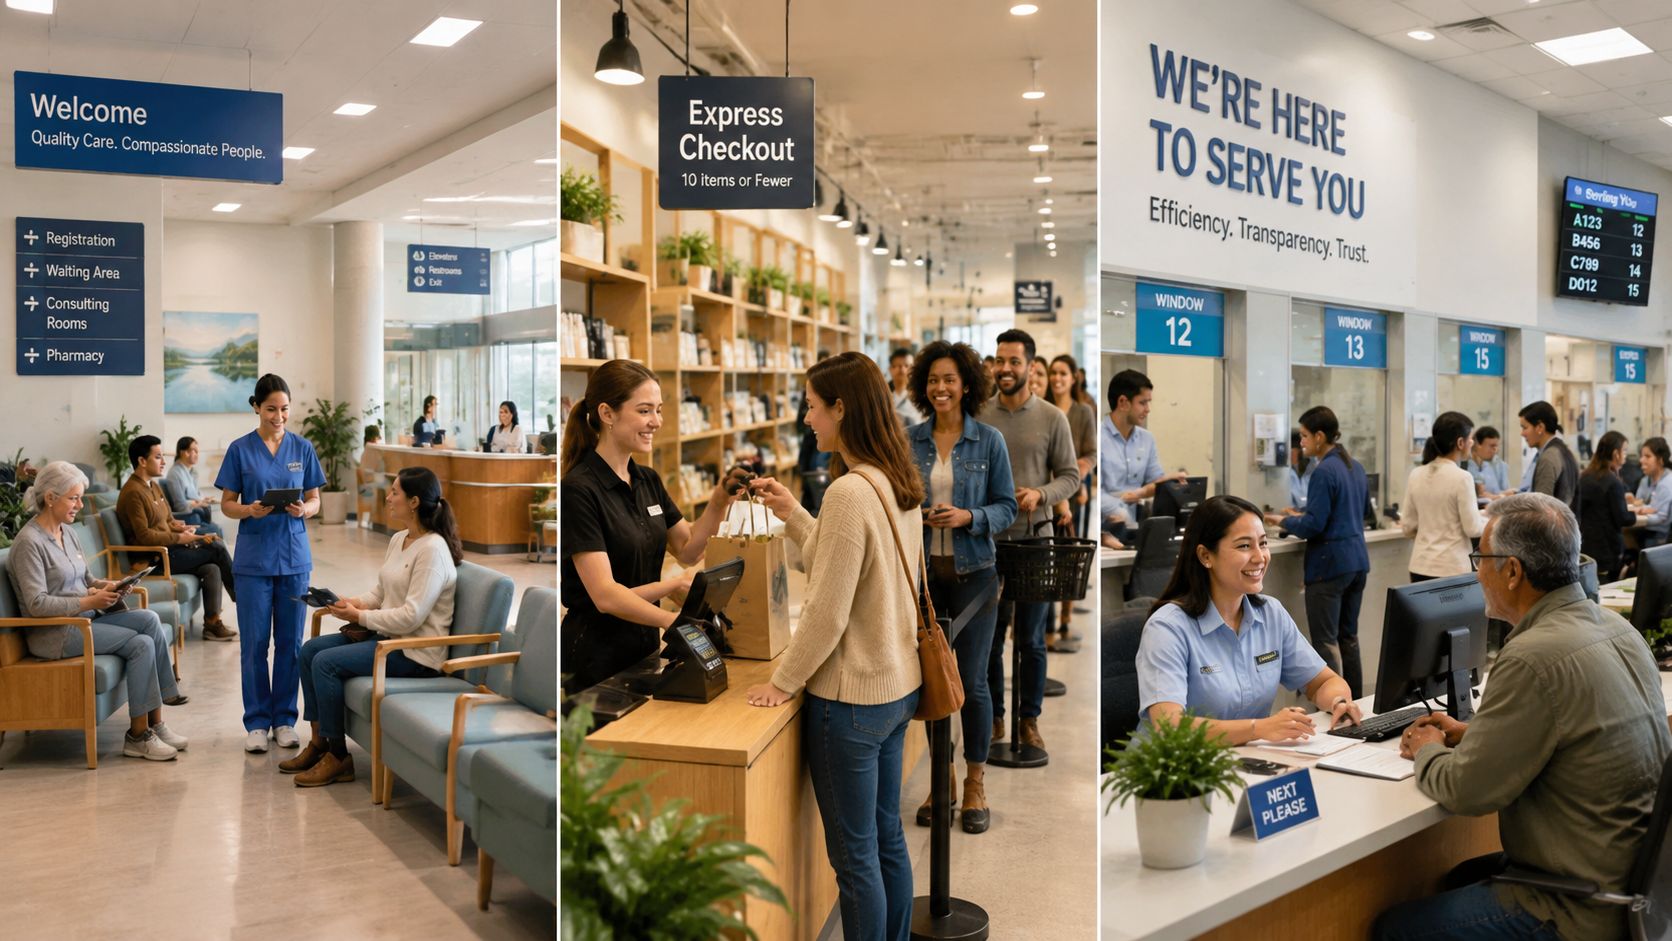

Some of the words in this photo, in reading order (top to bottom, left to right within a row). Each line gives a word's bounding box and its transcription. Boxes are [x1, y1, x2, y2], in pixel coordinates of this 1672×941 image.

[30, 92, 148, 125] Welcome
[689, 99, 784, 132] Express
[1272, 87, 1347, 157] HERE
[31, 129, 80, 150] Quality
[83, 133, 118, 150] Care.
[121, 136, 219, 156] Compassionate
[221, 142, 267, 162] People.
[679, 133, 796, 161] Checkout
[681, 173, 697, 187] 10
[701, 173, 736, 187] items
[739, 176, 752, 187] or
[755, 173, 793, 187] Fewer
[1150, 118, 1197, 178] TO
[1206, 137, 1304, 206] SERVE
[1311, 166, 1366, 220] YOU
[1150, 196, 1234, 242] Efficiency.
[1238, 216, 1333, 261] Transparency.
[1335, 238, 1370, 264] Trust.
[1573, 213, 1602, 230] A123
[1632, 223, 1644, 237] 12
[46, 231, 116, 248] Registration
[1572, 233, 1601, 250] B456
[1631, 243, 1643, 257] 13
[46, 264, 90, 281] Waiting
[93, 265, 120, 279] Area
[1629, 263, 1641, 278] 14
[1627, 283, 1640, 297] 15
[46, 296, 110, 313] Consulting
[1155, 293, 1204, 312] WINDOW
[46, 316, 88, 330] Rooms
[1165, 316, 1192, 347] 12
[46, 348, 105, 365] Pharmacy
[1345, 334, 1364, 360] 13
[1474, 347, 1490, 370] 15
[1625, 363, 1637, 379] 15
[1266, 782, 1297, 804] NEXT
[1261, 797, 1307, 825] PLEASE
